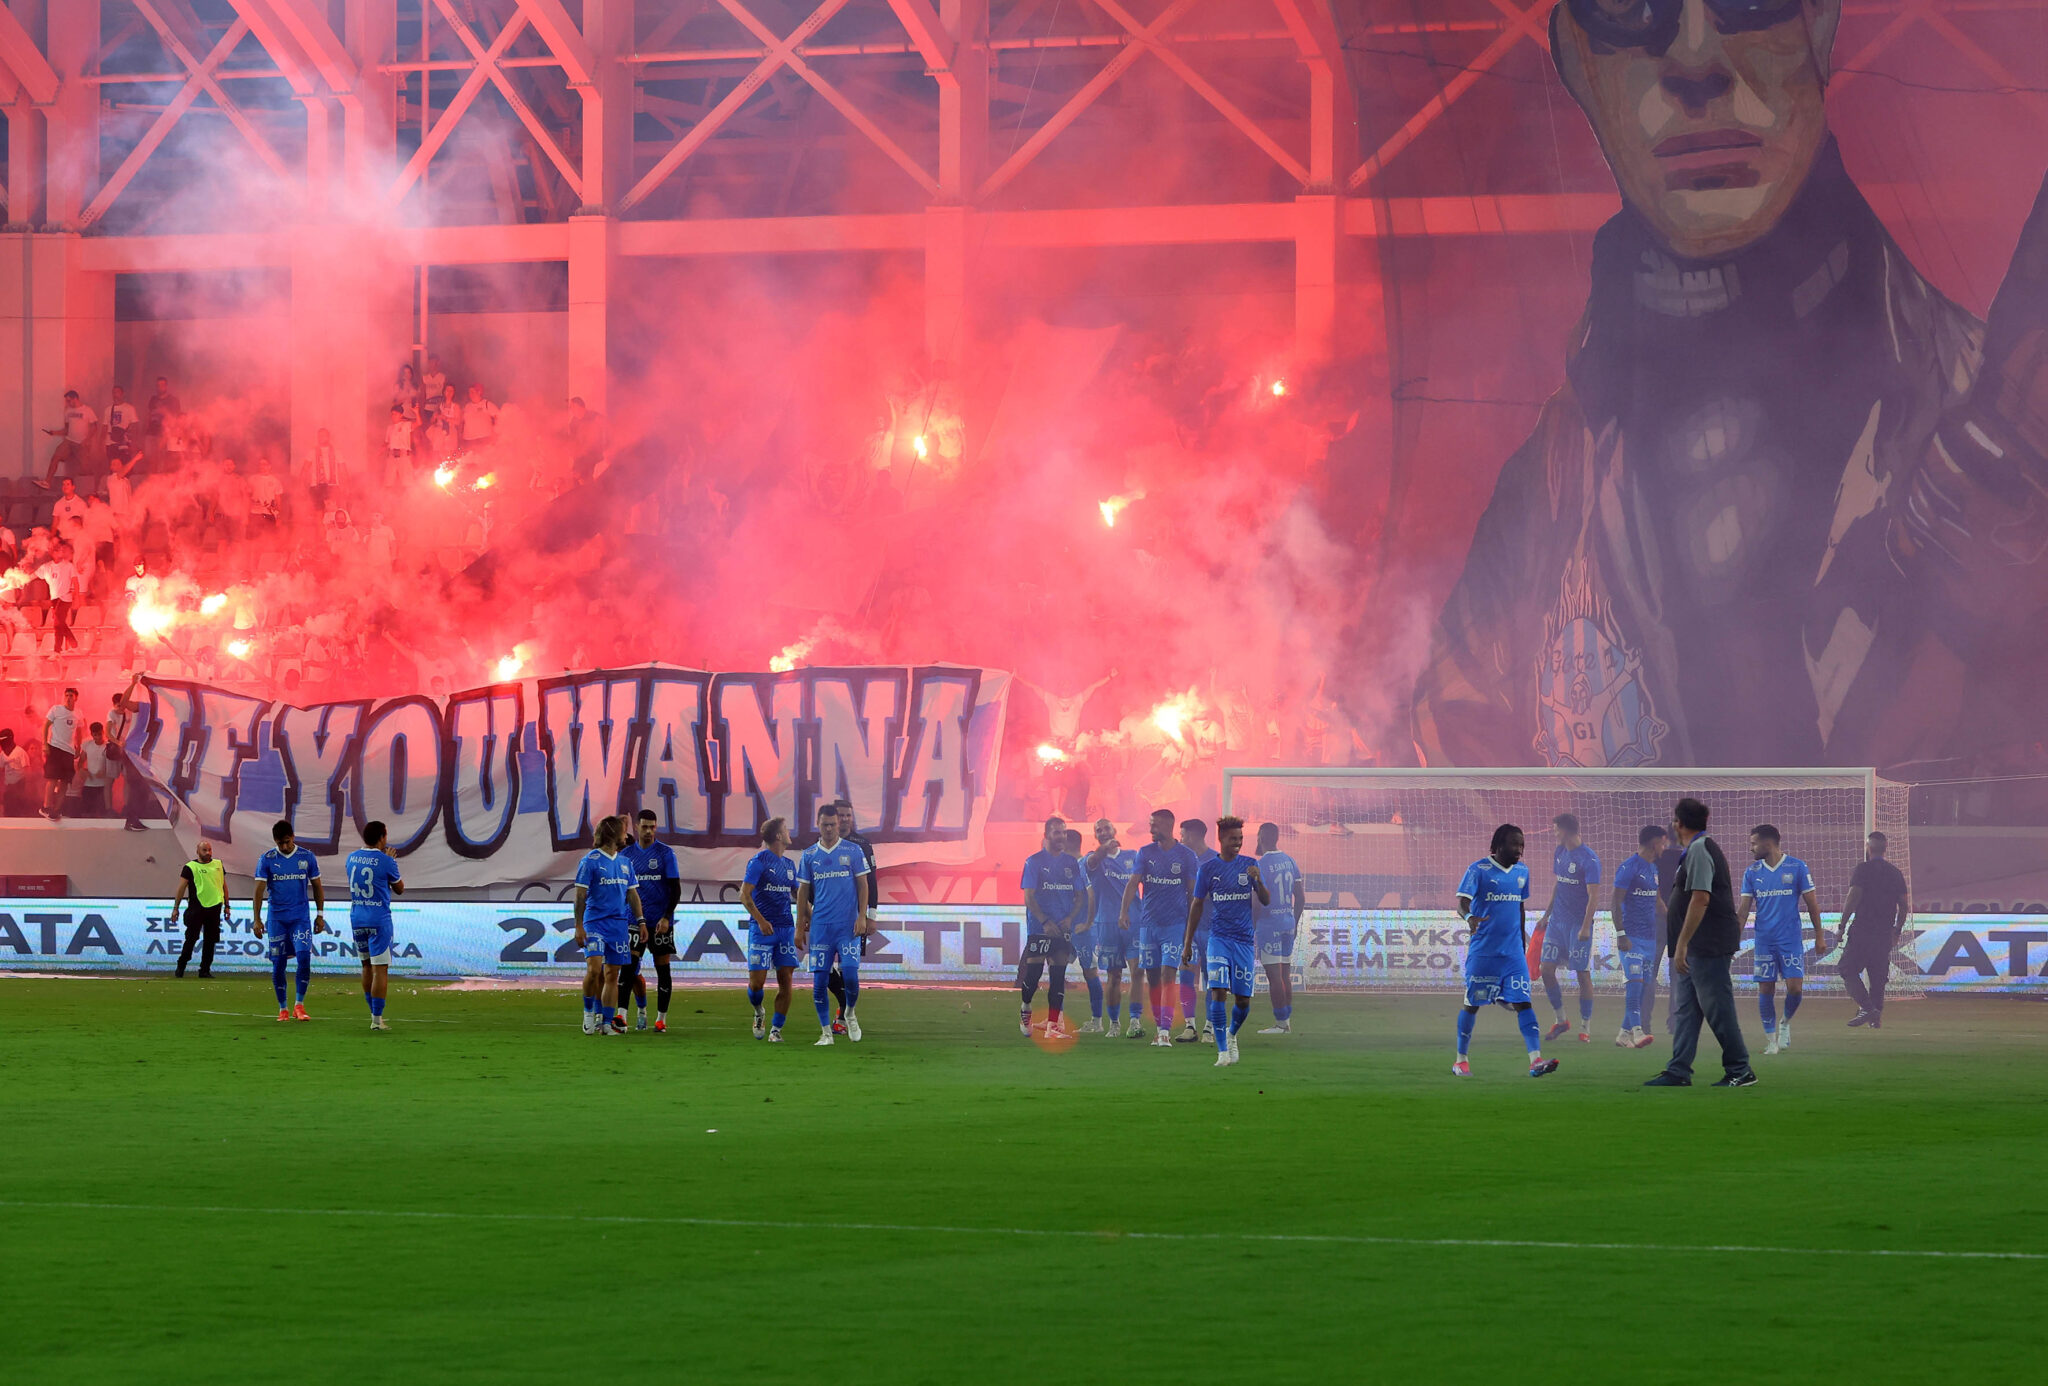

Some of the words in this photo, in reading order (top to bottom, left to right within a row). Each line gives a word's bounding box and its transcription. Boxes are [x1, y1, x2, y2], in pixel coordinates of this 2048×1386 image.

[1572, 722, 1597, 740] G1
[139, 676, 273, 843] IF
[272, 684, 522, 859] YOU
[538, 667, 983, 852] WANNA
[349, 855, 379, 867] MARQUES
[350, 865, 375, 899] 43
[814, 869, 850, 881] Stoiximan
[1755, 888, 1794, 898] Stoiximan
[146, 917, 180, 933] ΣΕ
[1311, 928, 1350, 946] ΣΕ
[818, 952, 825, 968] 3
[1543, 944, 1559, 960] 20
[1310, 952, 1460, 973] ΛΕΜΕΣΟ,
